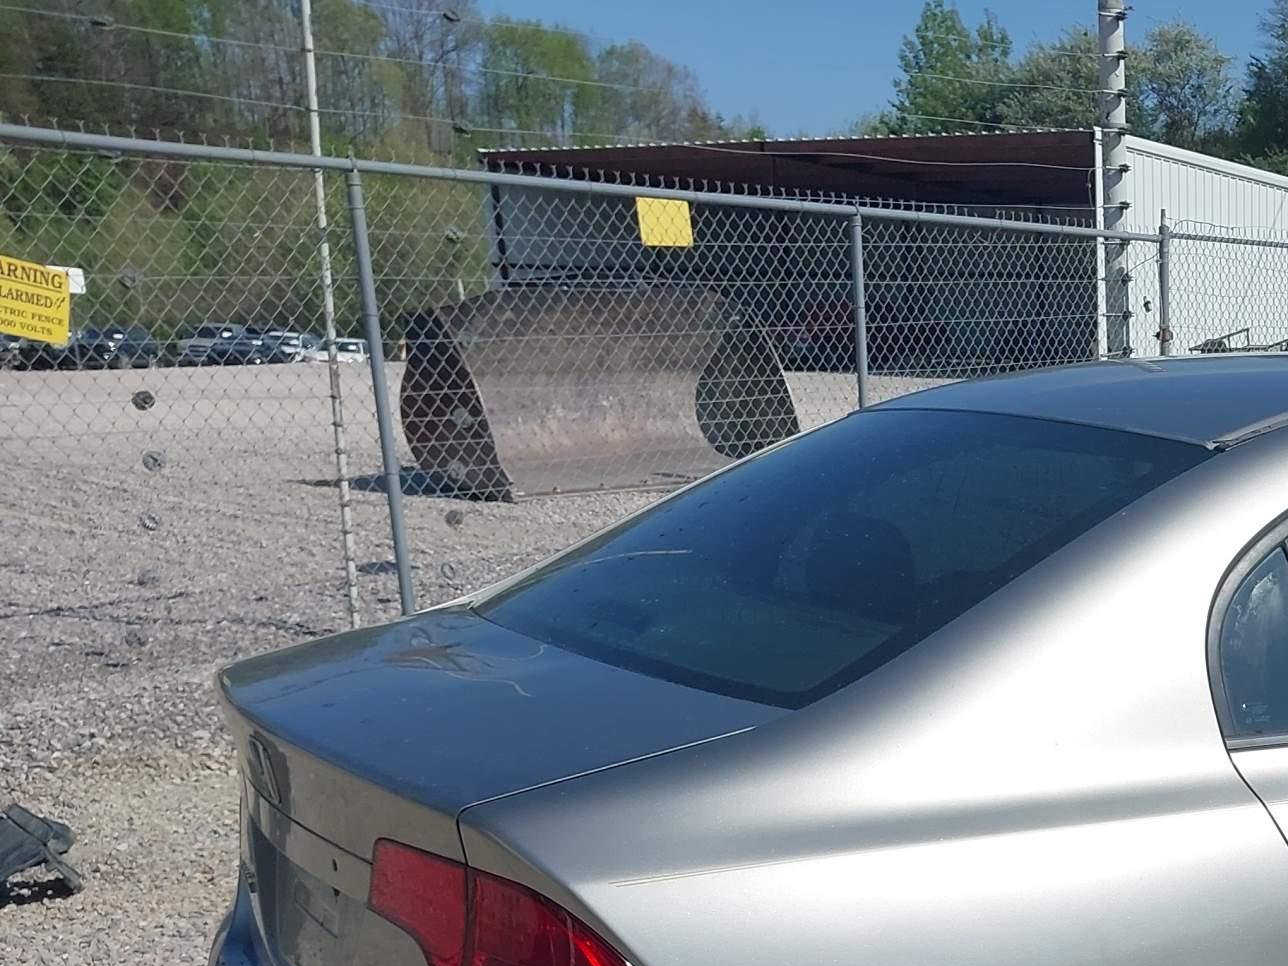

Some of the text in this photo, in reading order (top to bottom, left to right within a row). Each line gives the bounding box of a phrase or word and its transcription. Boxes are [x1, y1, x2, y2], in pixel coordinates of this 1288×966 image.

[0, 305, 64, 327] TRIC FENCE
[20, 321, 53, 336] VOLTS
